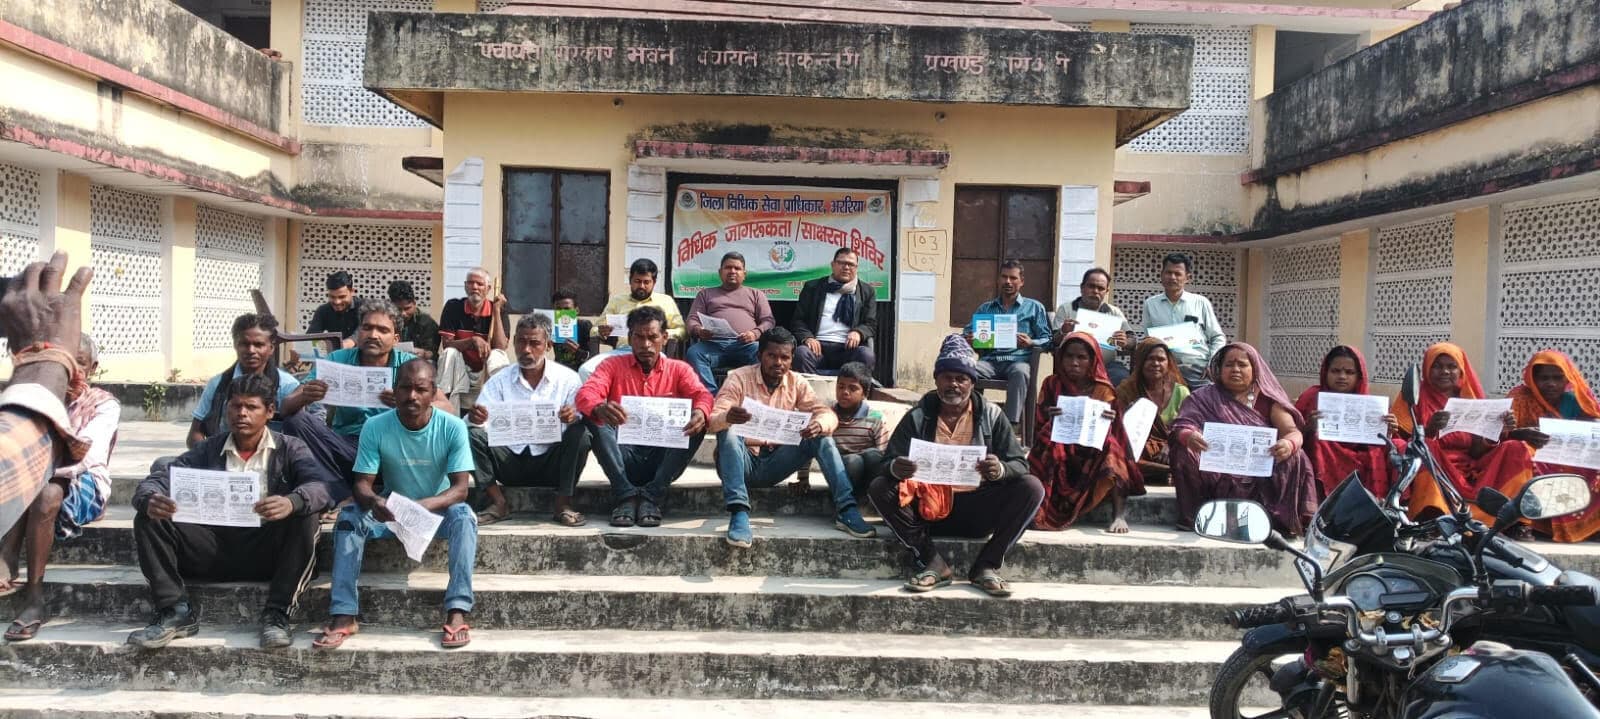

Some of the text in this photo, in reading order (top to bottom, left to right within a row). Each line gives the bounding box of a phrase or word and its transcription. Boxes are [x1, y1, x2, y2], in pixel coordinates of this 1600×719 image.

[626, 44, 678, 65] भवन
[924, 54, 985, 75] प्रखण्ड
[700, 192, 724, 210] जिला
[727, 193, 759, 211] विधिक
[762, 194, 781, 212] सेवा
[831, 195, 865, 213] अररिया
[677, 230, 718, 267] विधिक
[851, 228, 886, 271] शिविर
[913, 233, 938, 251] 103
